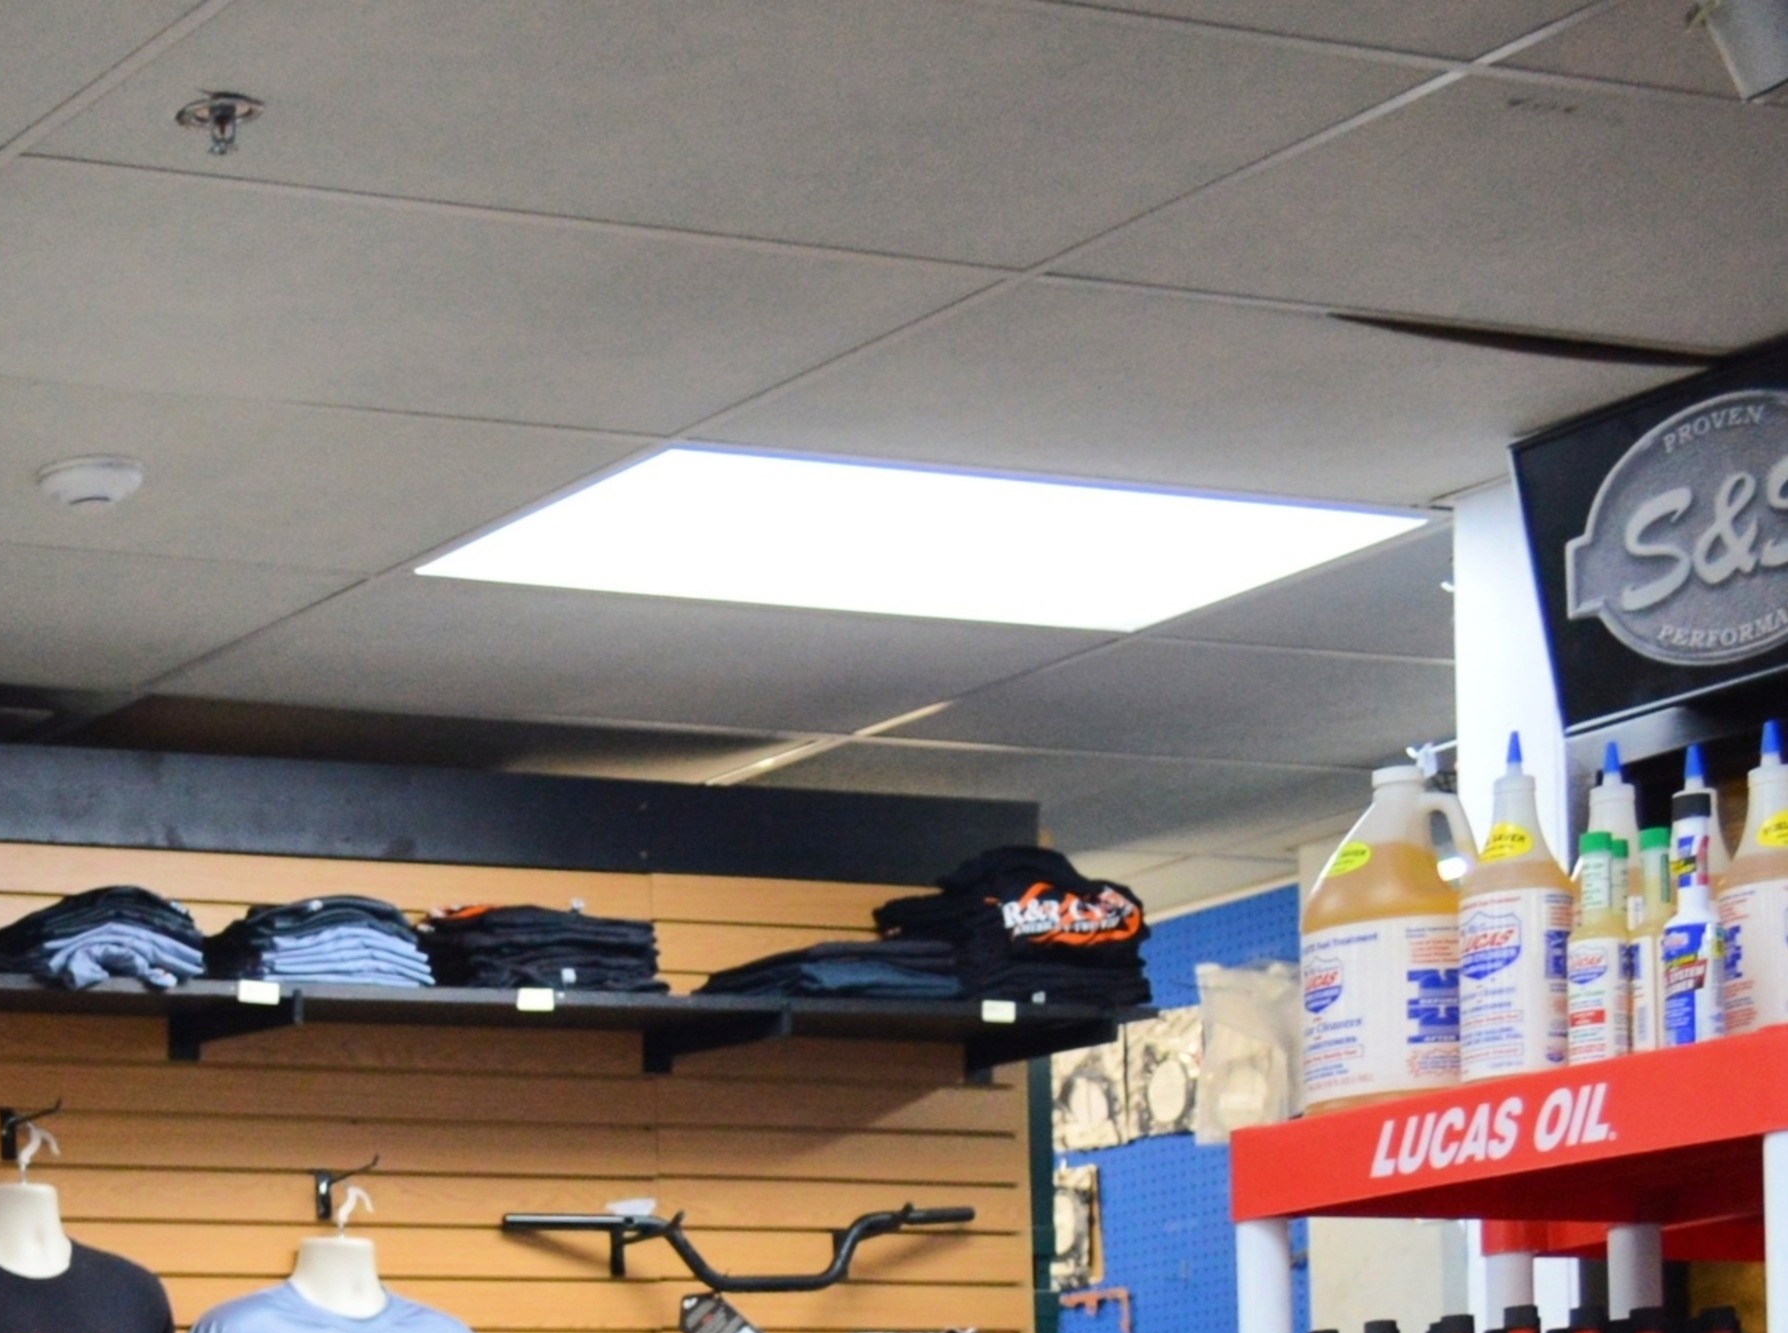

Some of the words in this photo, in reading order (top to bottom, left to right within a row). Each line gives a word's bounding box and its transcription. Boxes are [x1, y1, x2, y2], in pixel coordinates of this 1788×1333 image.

[1662, 404, 1766, 452] PROVEN
[1370, 1093, 1519, 1179] LUCAS
[1534, 1083, 1610, 1152] OIL
